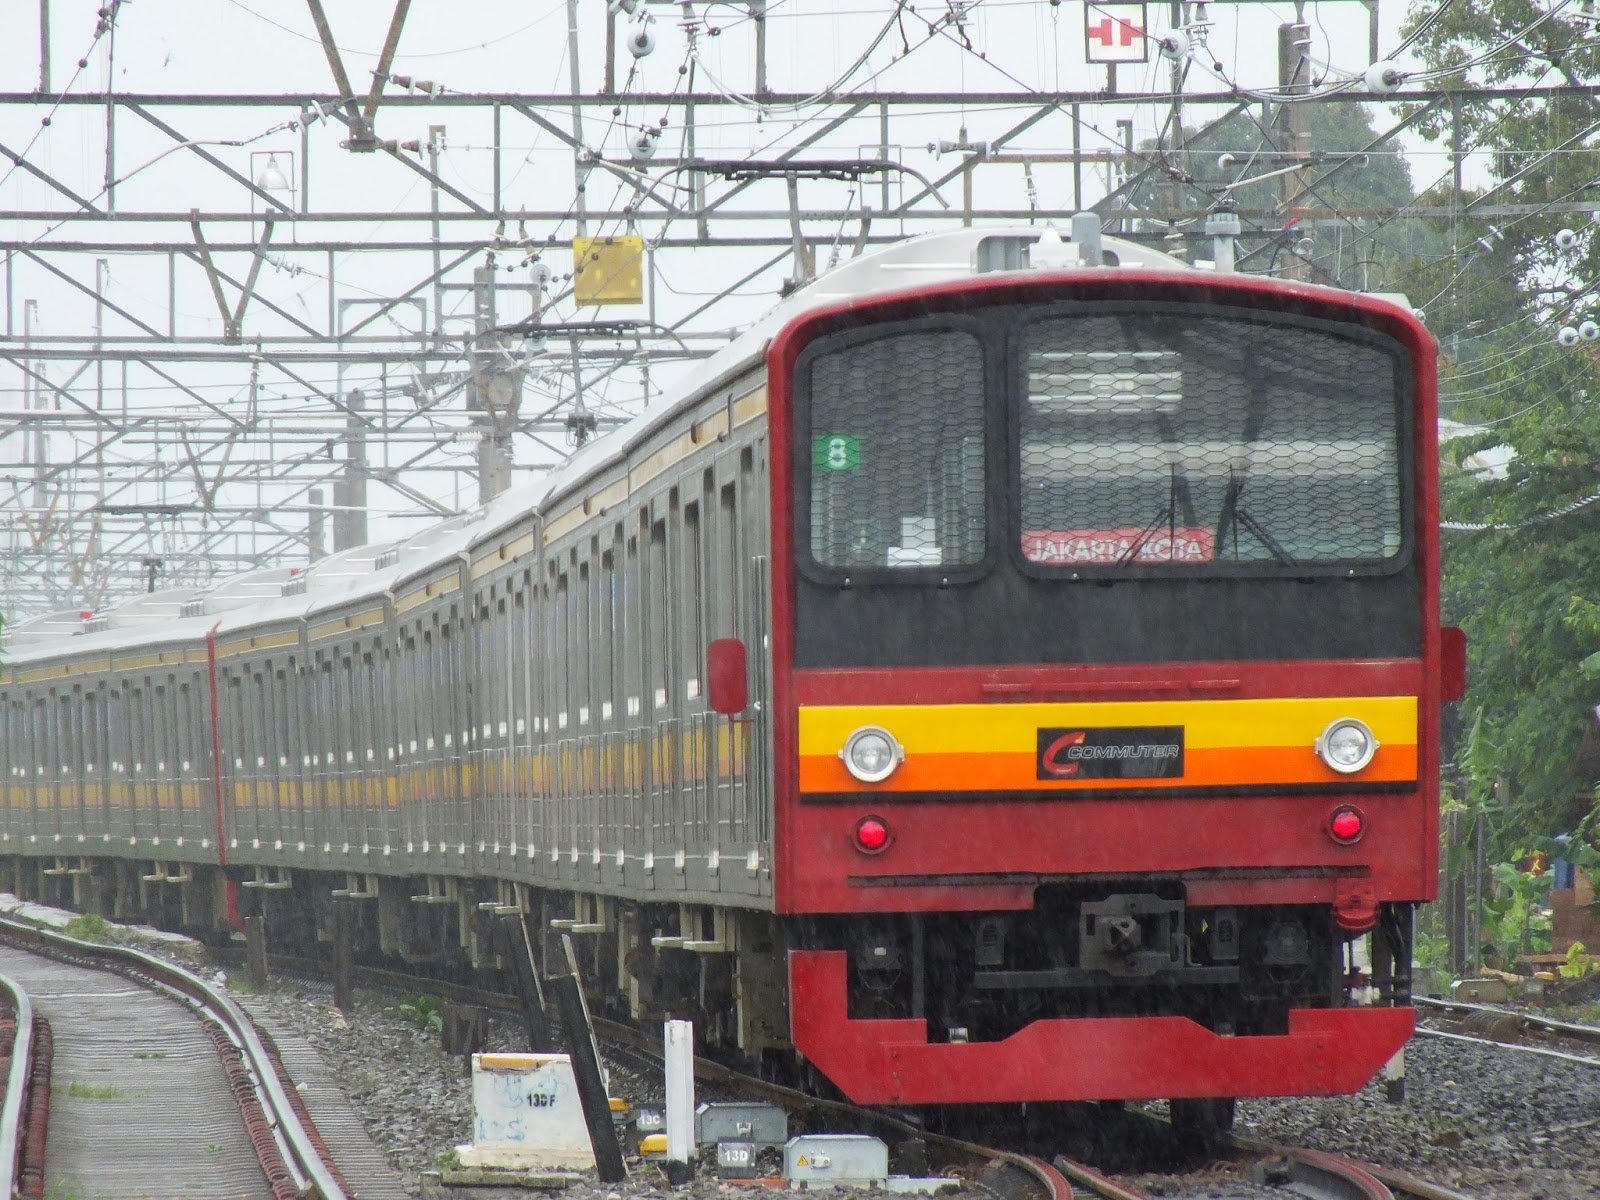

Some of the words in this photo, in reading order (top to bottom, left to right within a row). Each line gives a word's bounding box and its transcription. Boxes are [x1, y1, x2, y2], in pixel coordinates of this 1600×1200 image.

[827, 438, 848, 468] 8
[1029, 538, 1132, 561] JAKARTA
[1140, 537, 1204, 560] KOTA
[1068, 744, 1180, 759] COMMUTER
[639, 1114, 661, 1125] 13C
[724, 1149, 749, 1161] 13D
